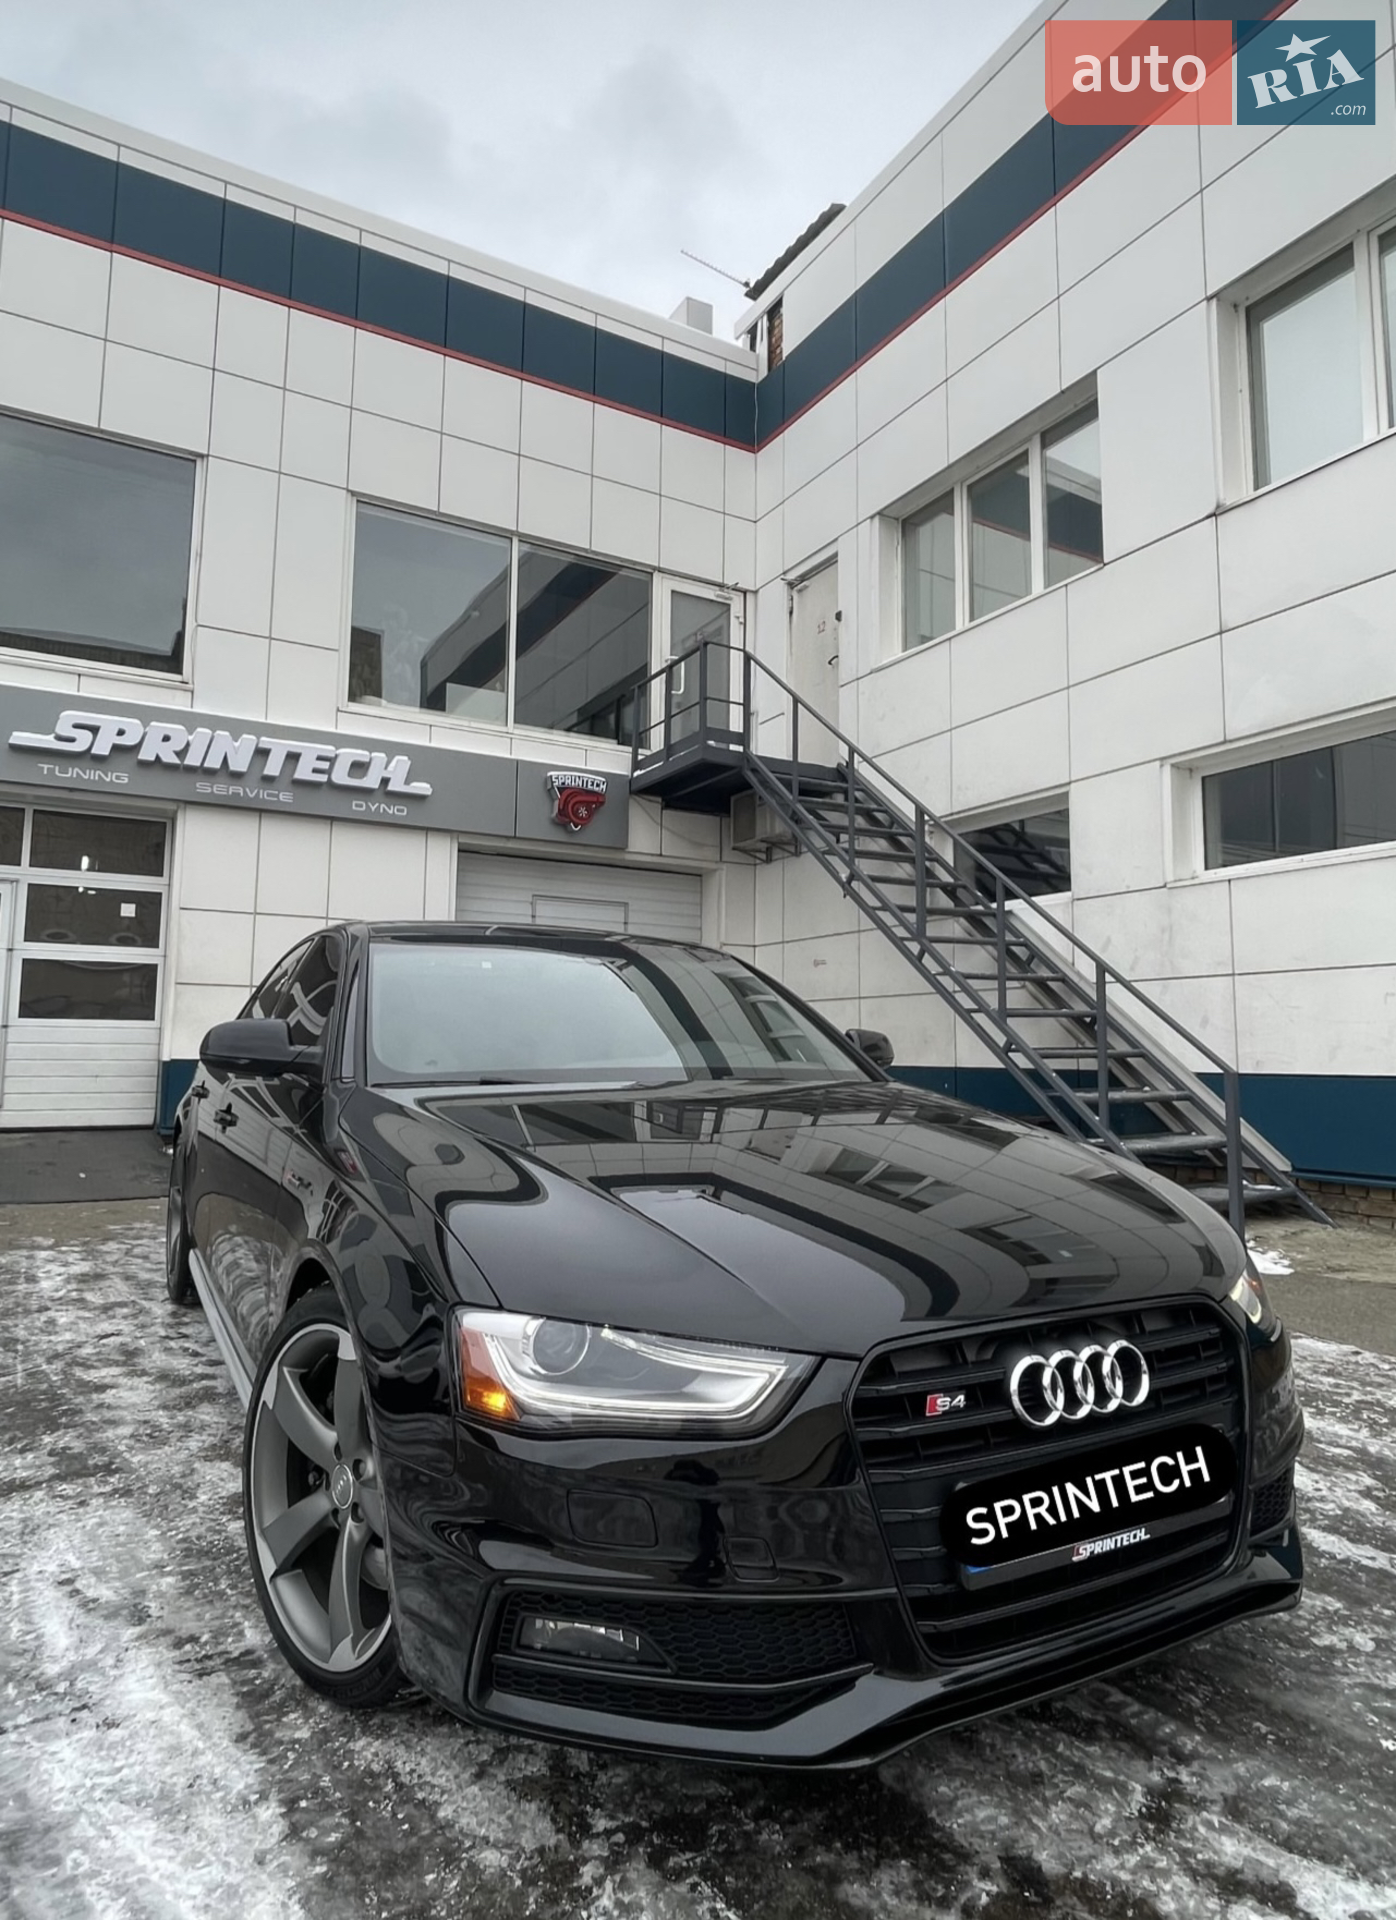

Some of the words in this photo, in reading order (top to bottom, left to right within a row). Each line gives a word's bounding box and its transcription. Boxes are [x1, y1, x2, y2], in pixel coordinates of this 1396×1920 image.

[8, 710, 433, 797] SPRINTECH
[37, 763, 130, 784] TUNING
[195, 782, 294, 802] SERVICE
[352, 800, 408, 816] DYNO
[552, 775, 607, 794] SPRINTECH
[934, 1394, 966, 1412] S4
[1072, 1527, 1151, 1562] SPRINTECH
